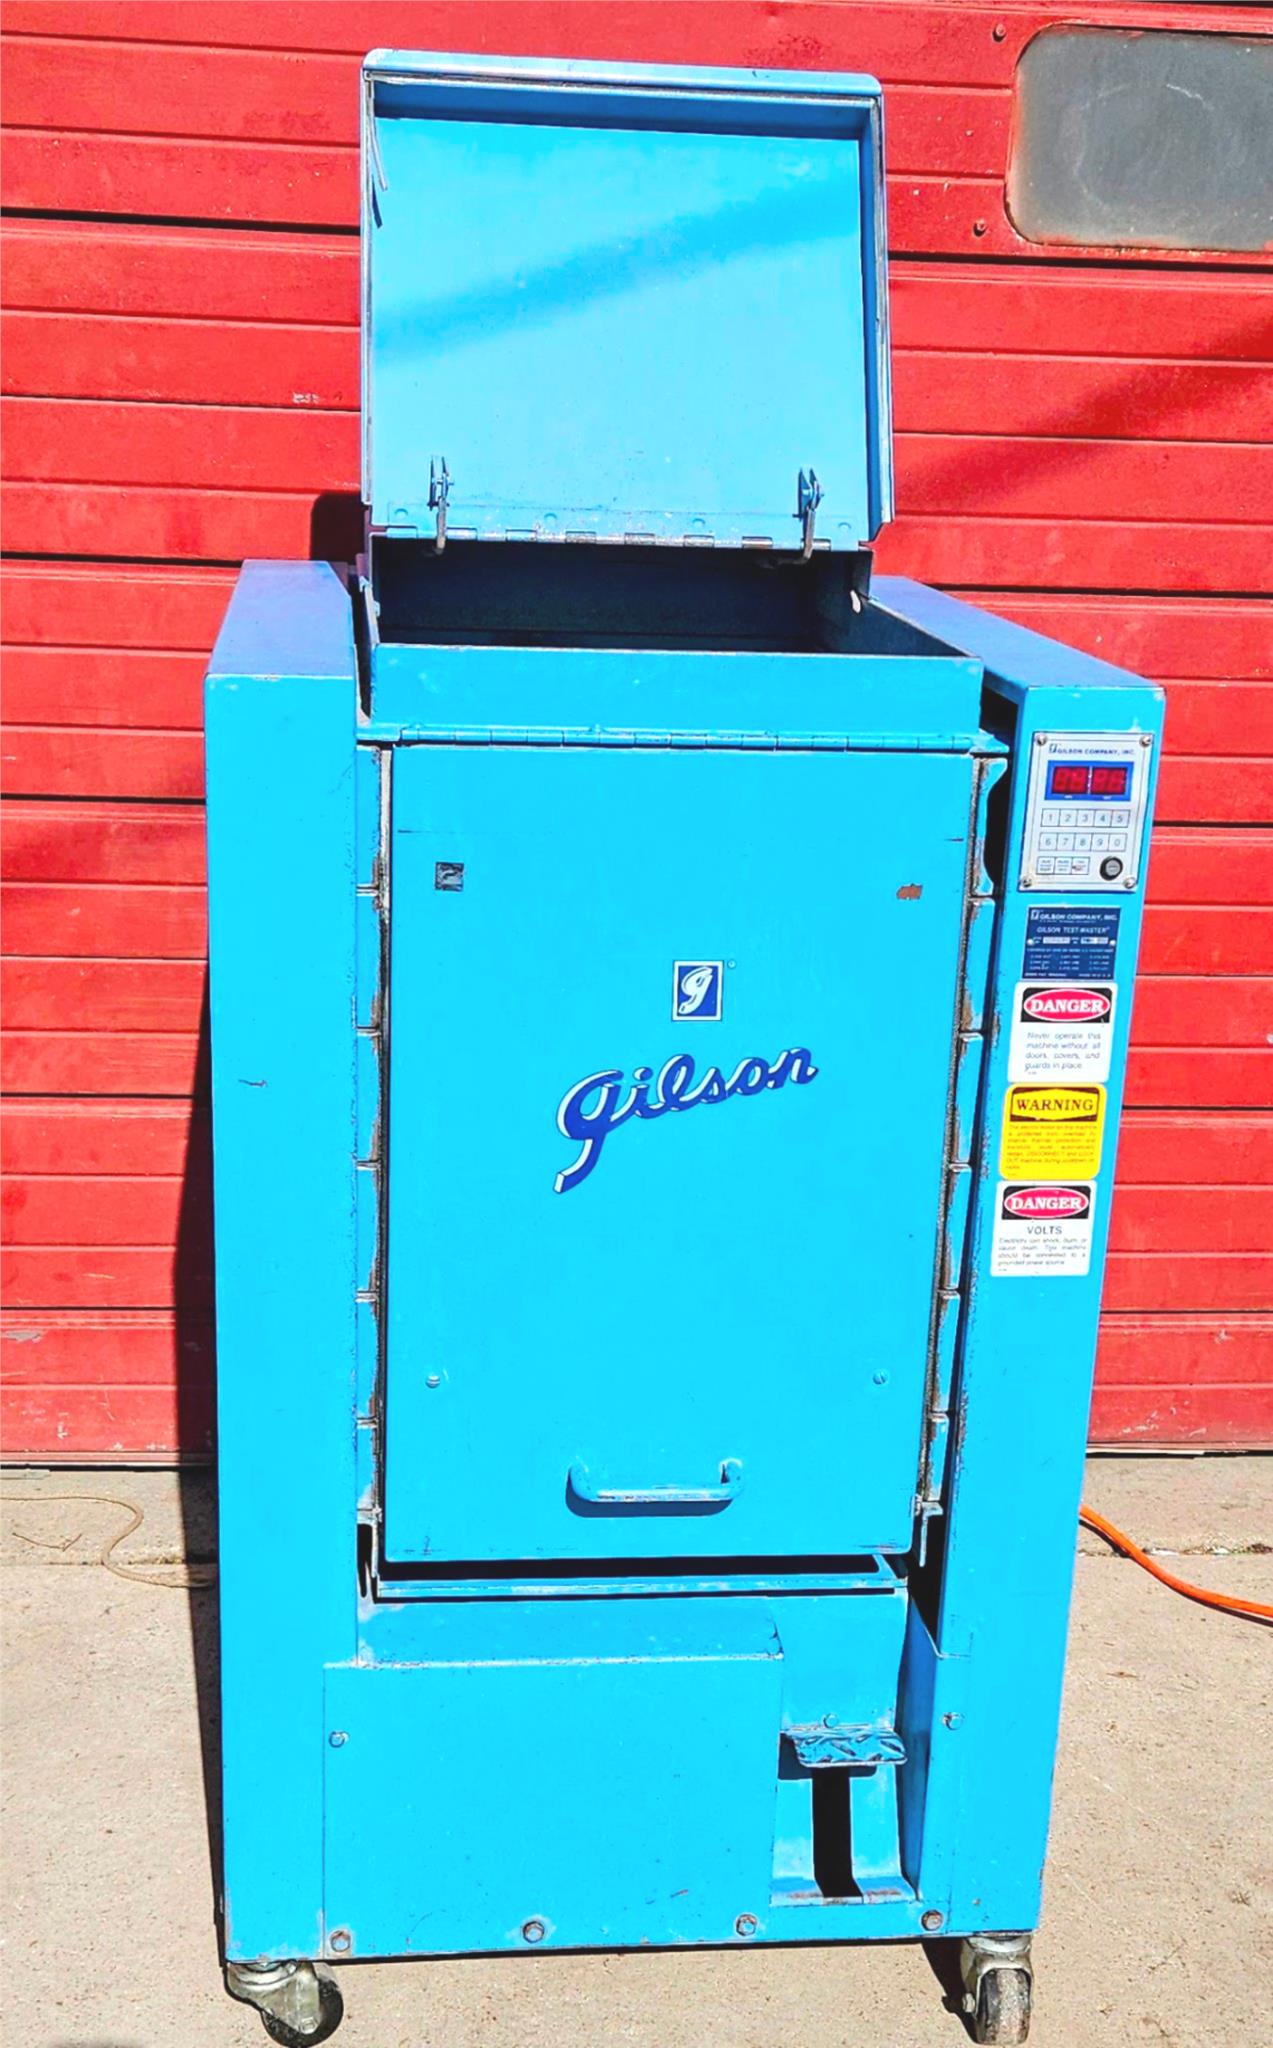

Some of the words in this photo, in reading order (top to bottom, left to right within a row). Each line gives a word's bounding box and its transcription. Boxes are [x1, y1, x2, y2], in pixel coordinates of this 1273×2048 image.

[1030, 999, 1103, 1012] DANGER
[1054, 1032, 1083, 1040] operate
[1017, 1099, 1094, 1111] WARNING
[1011, 1197, 1082, 1210] DANGER
[1027, 1226, 1063, 1235] VOLTS
